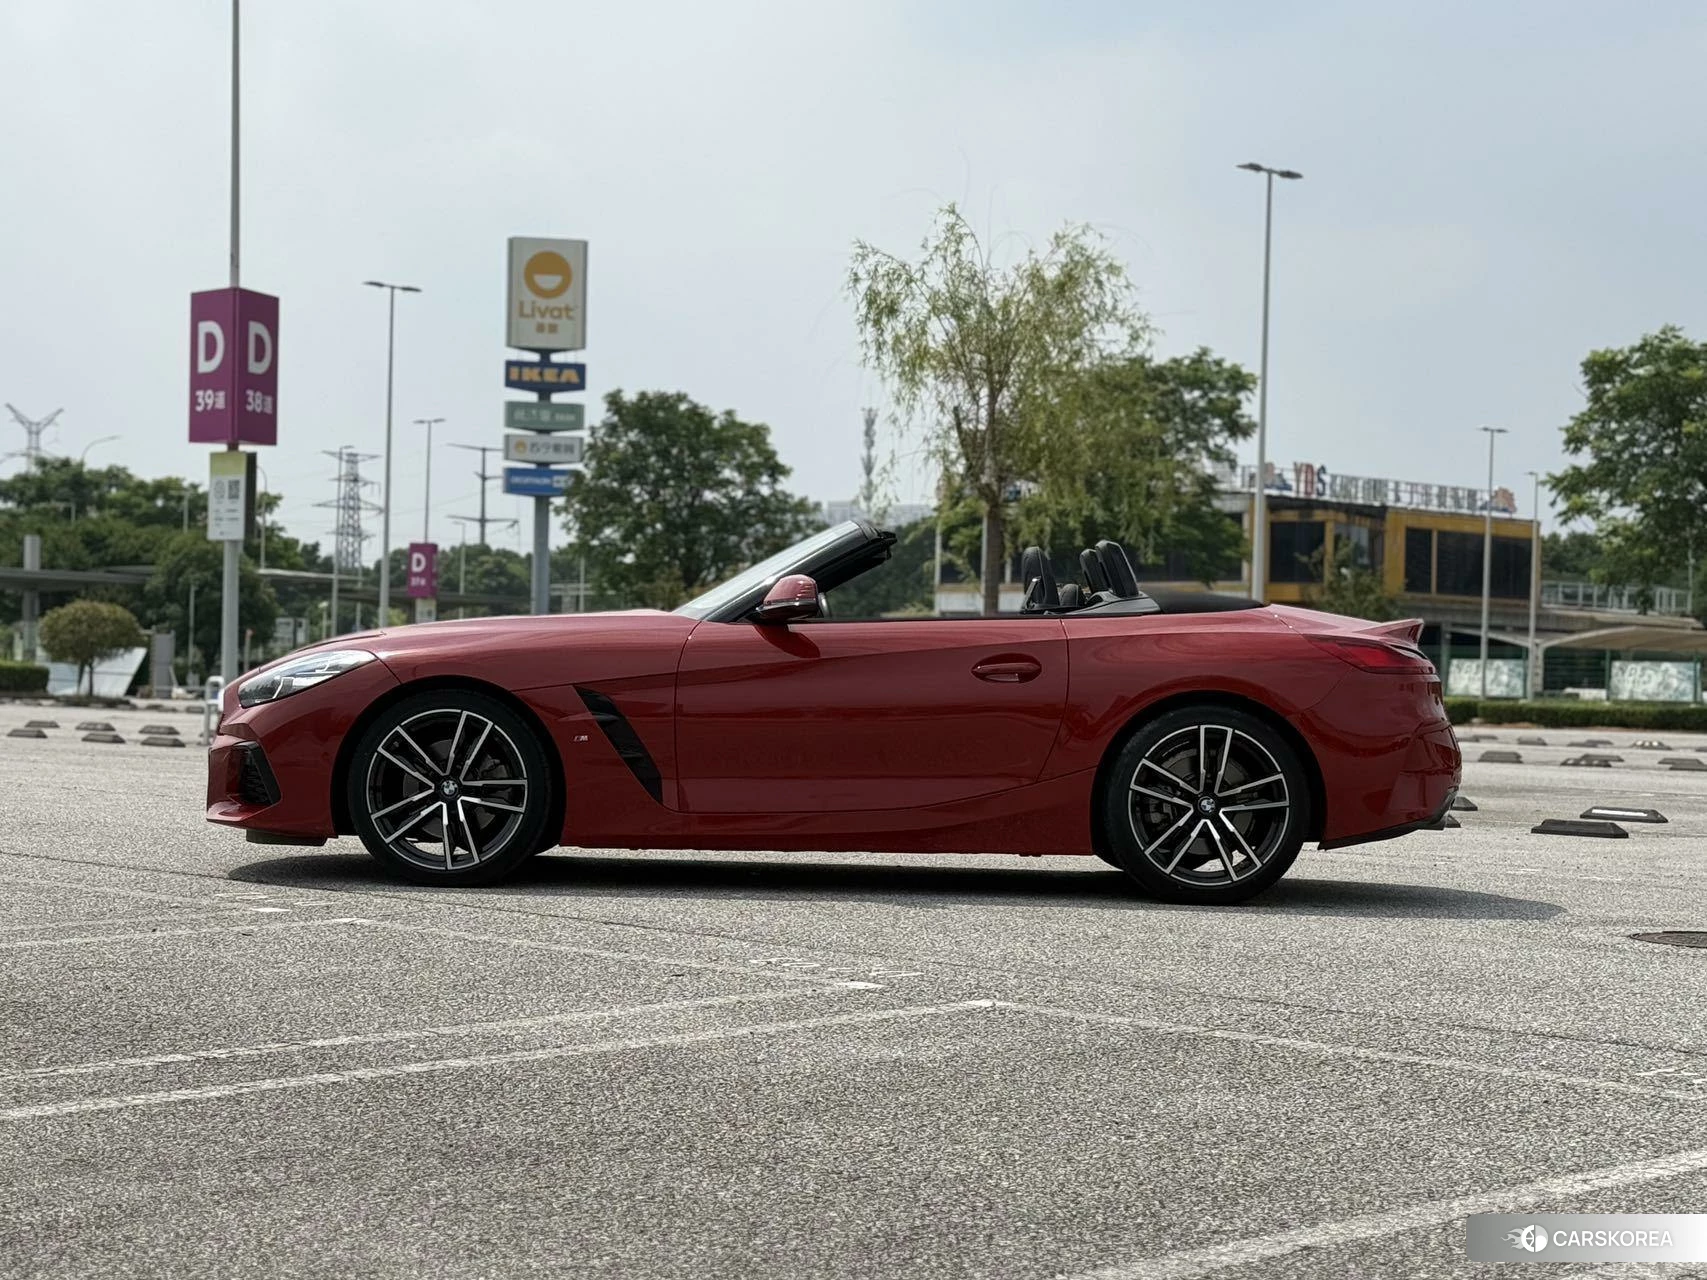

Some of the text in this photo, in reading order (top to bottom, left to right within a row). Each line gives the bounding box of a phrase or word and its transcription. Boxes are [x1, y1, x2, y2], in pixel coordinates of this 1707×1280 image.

[518, 300, 576, 321] Livat
[197, 320, 226, 375] D
[247, 320, 273, 375] D
[508, 366, 580, 385] IKEA
[411, 552, 427, 574] D
